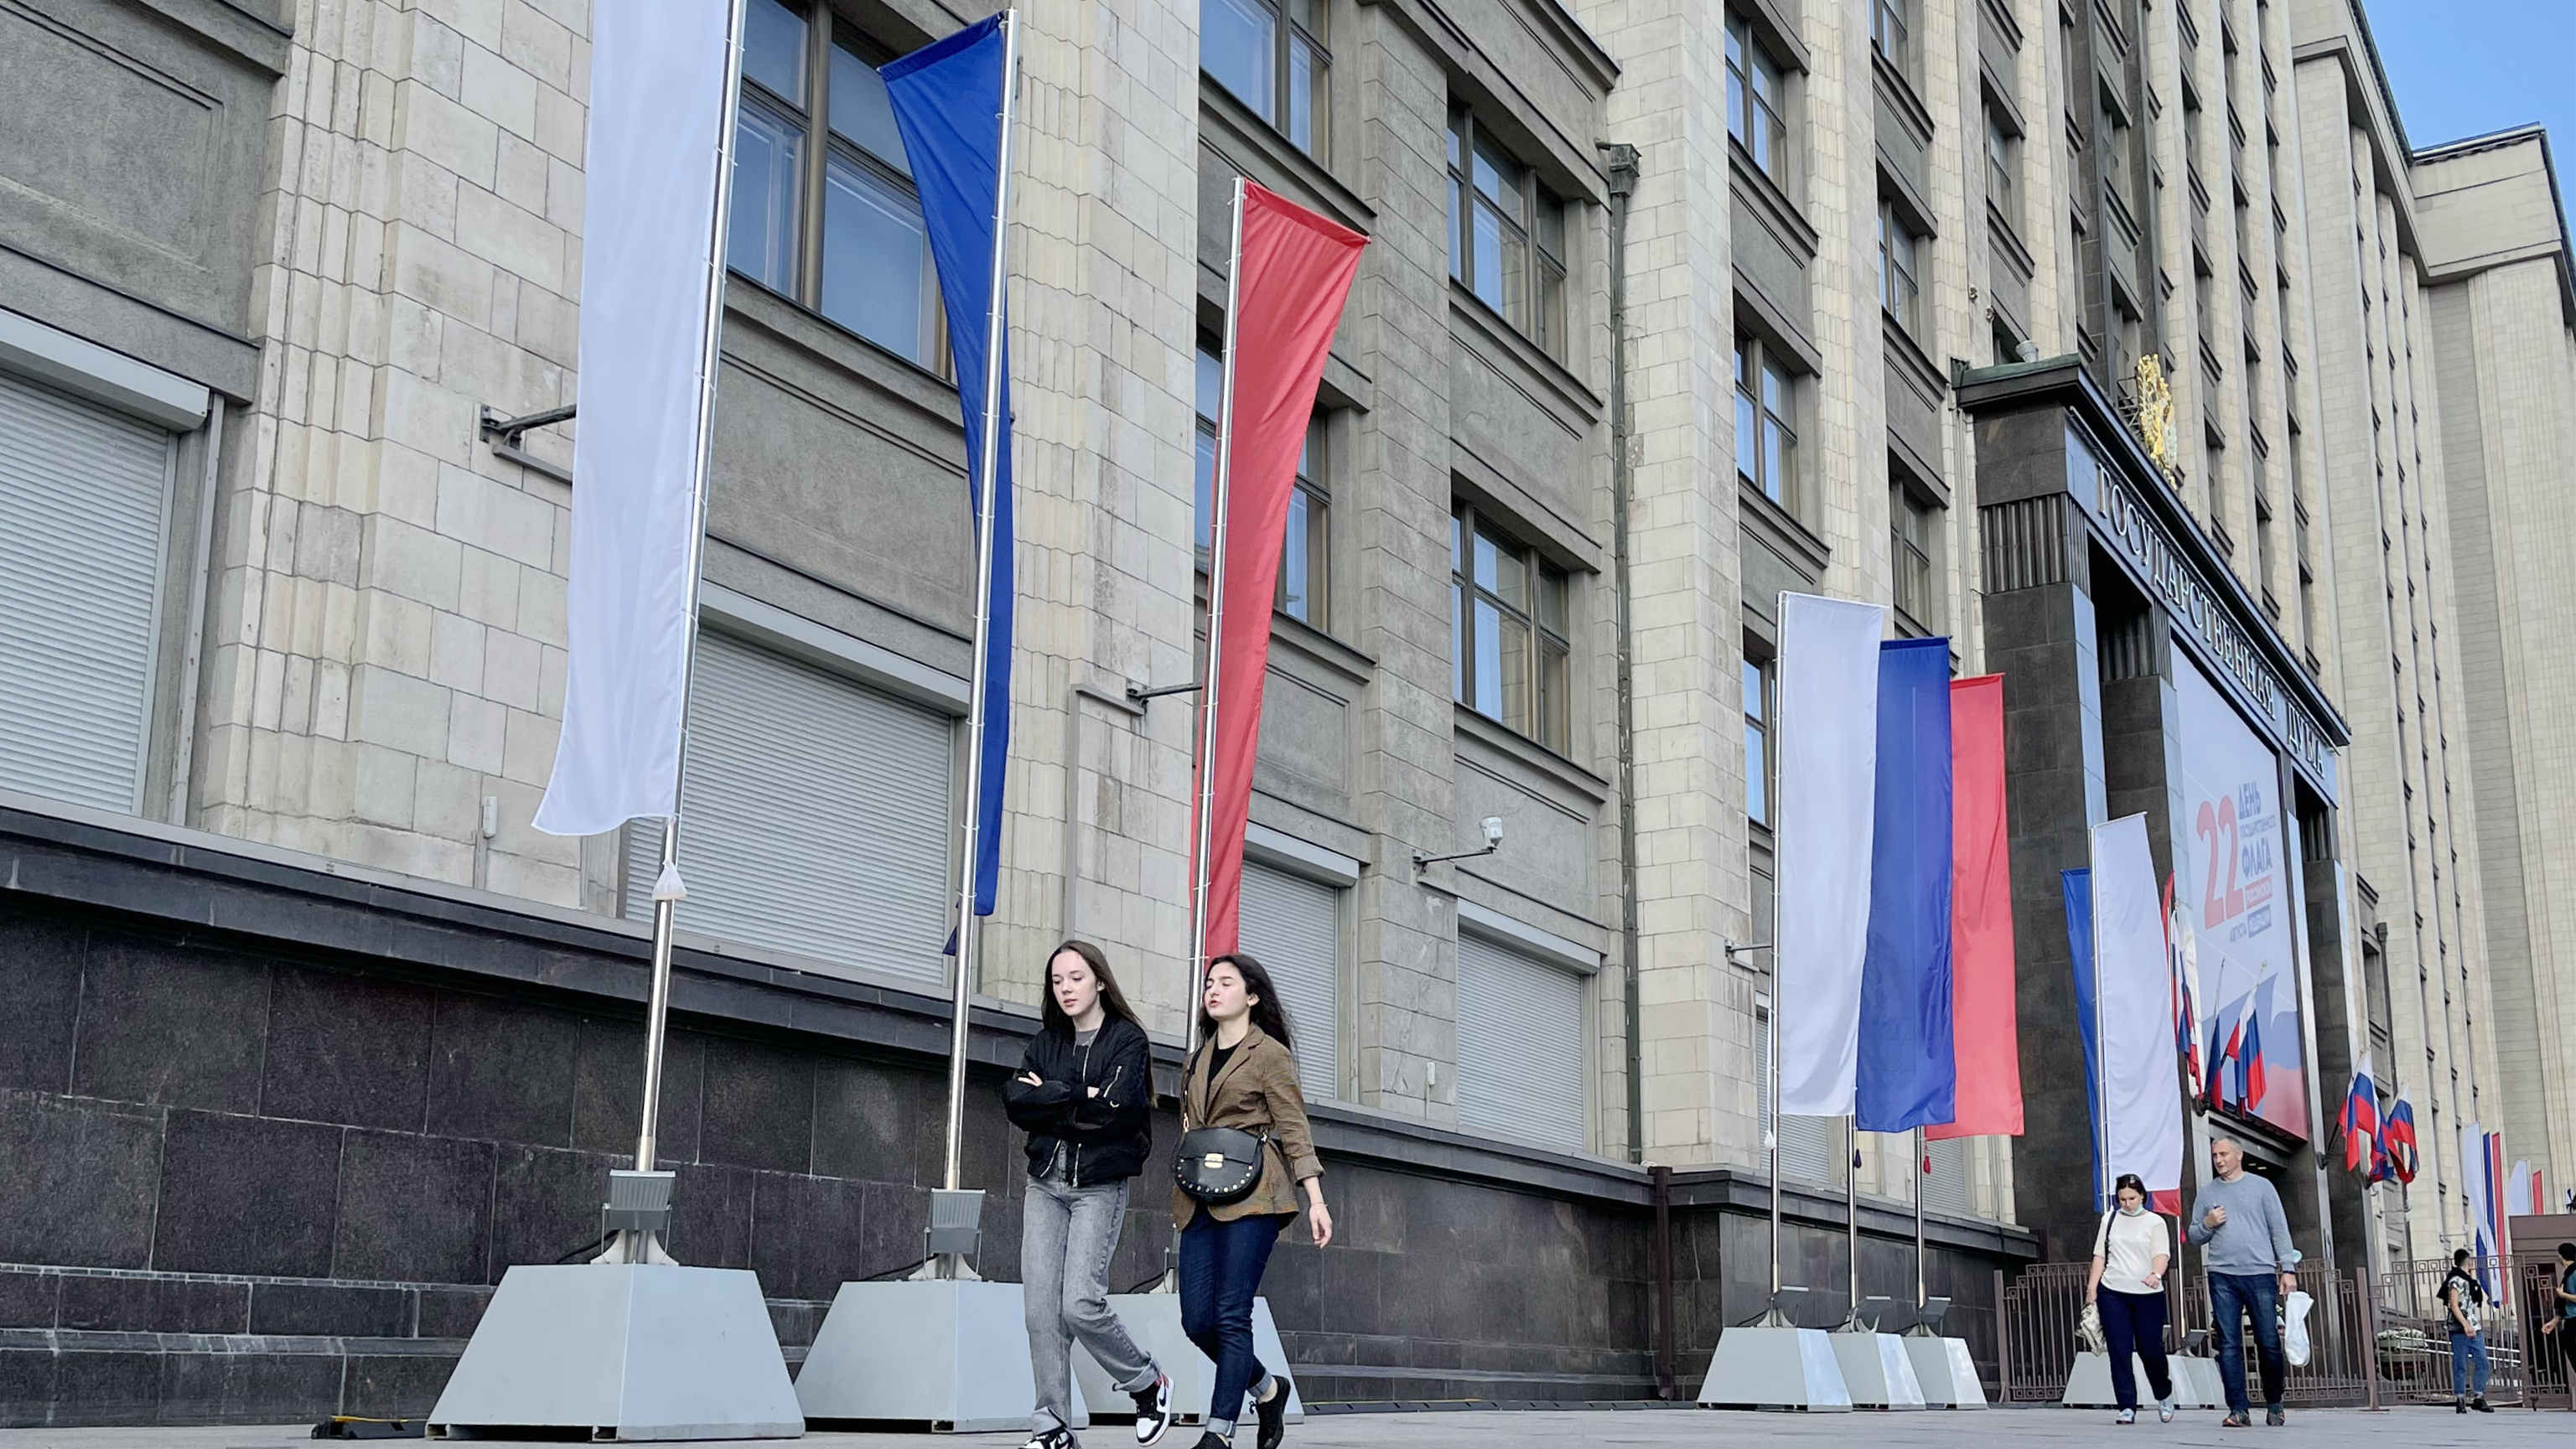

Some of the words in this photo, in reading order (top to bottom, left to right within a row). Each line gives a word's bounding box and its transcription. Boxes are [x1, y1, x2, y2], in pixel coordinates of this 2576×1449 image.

[2097, 463, 2277, 721] ГОСУДАРСТВЕННАЯ
[2286, 701, 2325, 779] ДУМА
[2239, 781, 2261, 820] ДЕНЬ
[2196, 794, 2245, 930] 22
[2242, 837, 2273, 877] ФЛАГА
